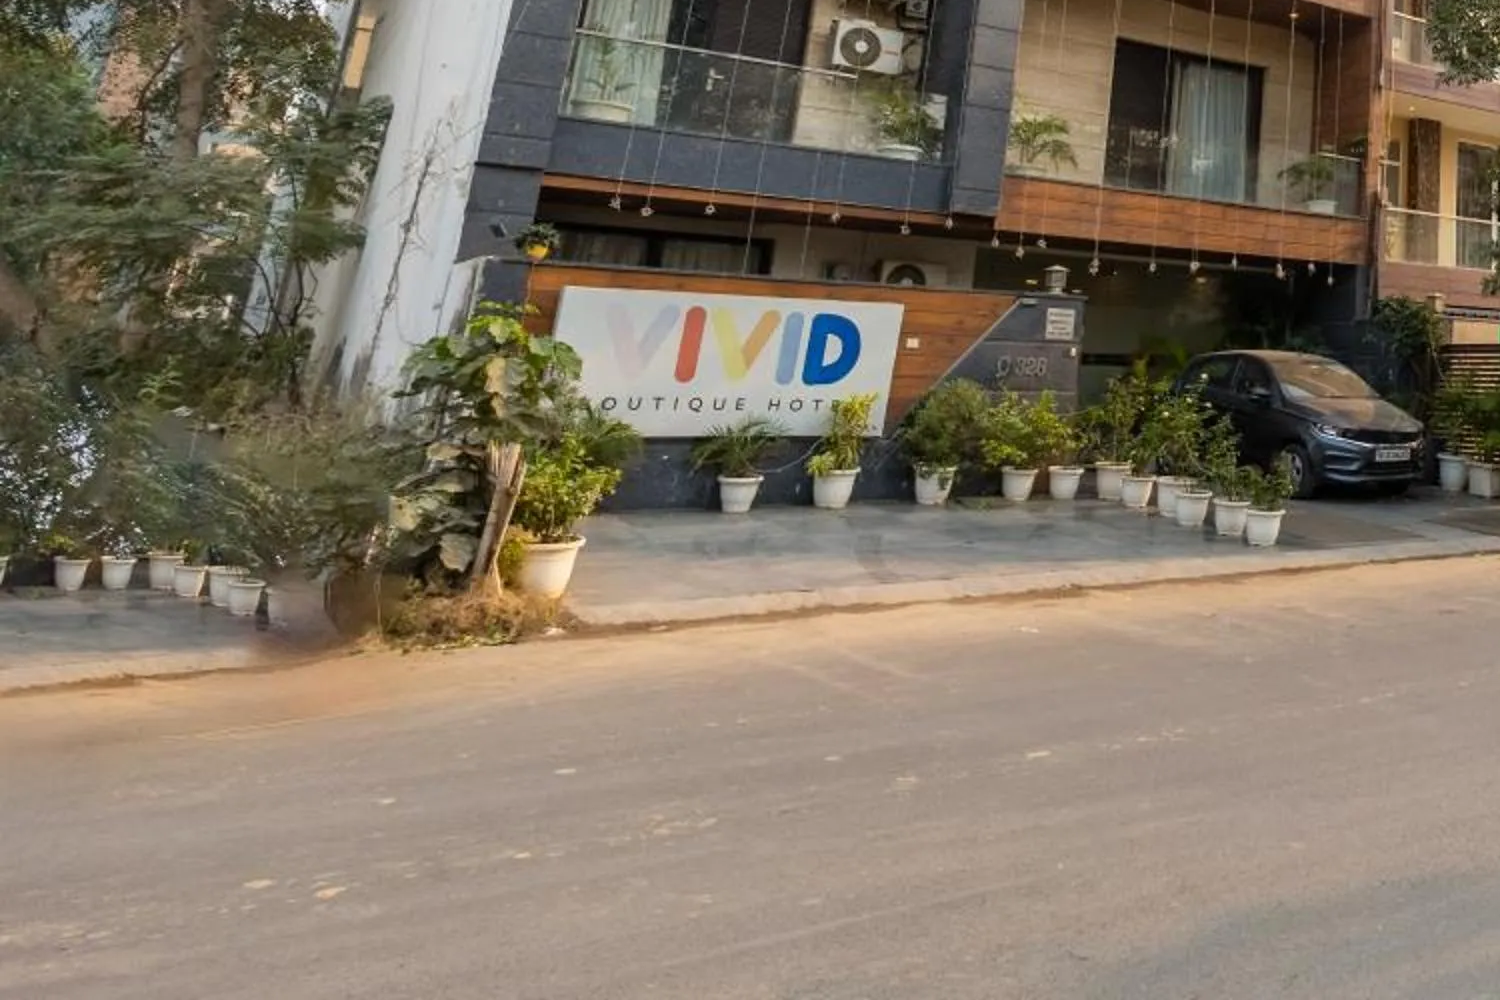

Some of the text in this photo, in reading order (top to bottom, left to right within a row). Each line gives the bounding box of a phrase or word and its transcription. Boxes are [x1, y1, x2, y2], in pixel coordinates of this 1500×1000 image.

[607, 305, 861, 385] VIVID
[600, 397, 843, 412] OUTIQUE HOT
